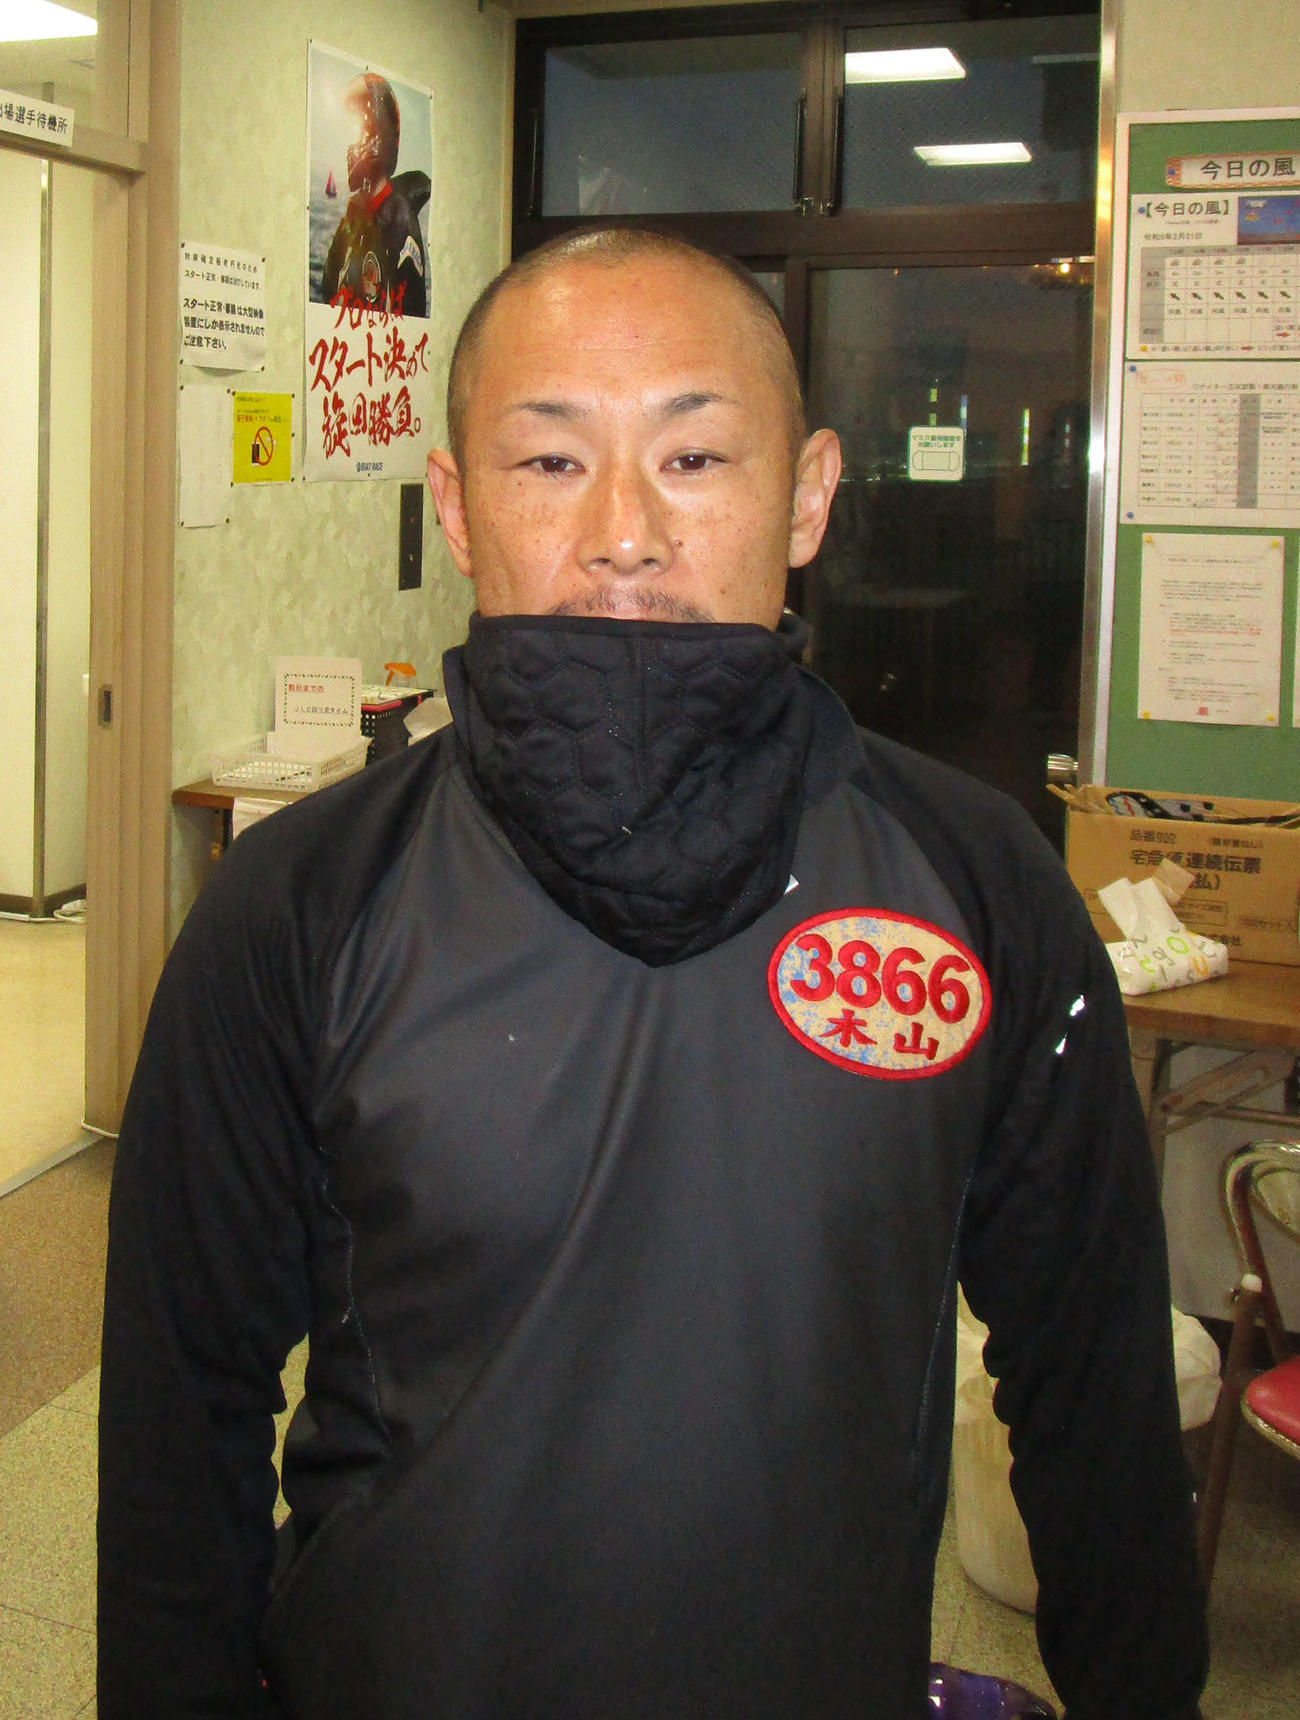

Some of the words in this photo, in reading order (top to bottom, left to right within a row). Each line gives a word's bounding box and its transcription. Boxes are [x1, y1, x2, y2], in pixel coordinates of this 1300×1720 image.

[0, 103, 68, 134] 場選手待機所
[1200, 157, 1296, 180] 今日の風
[1146, 199, 1229, 218] 【今日の風】
[309, 326, 429, 393] スタート決めて
[1130, 849, 1262, 874] 宅急便連続伝票
[1189, 871, 1222, 890] 払)
[790, 934, 971, 1024] 3866
[819, 1008, 939, 1061] 木山
